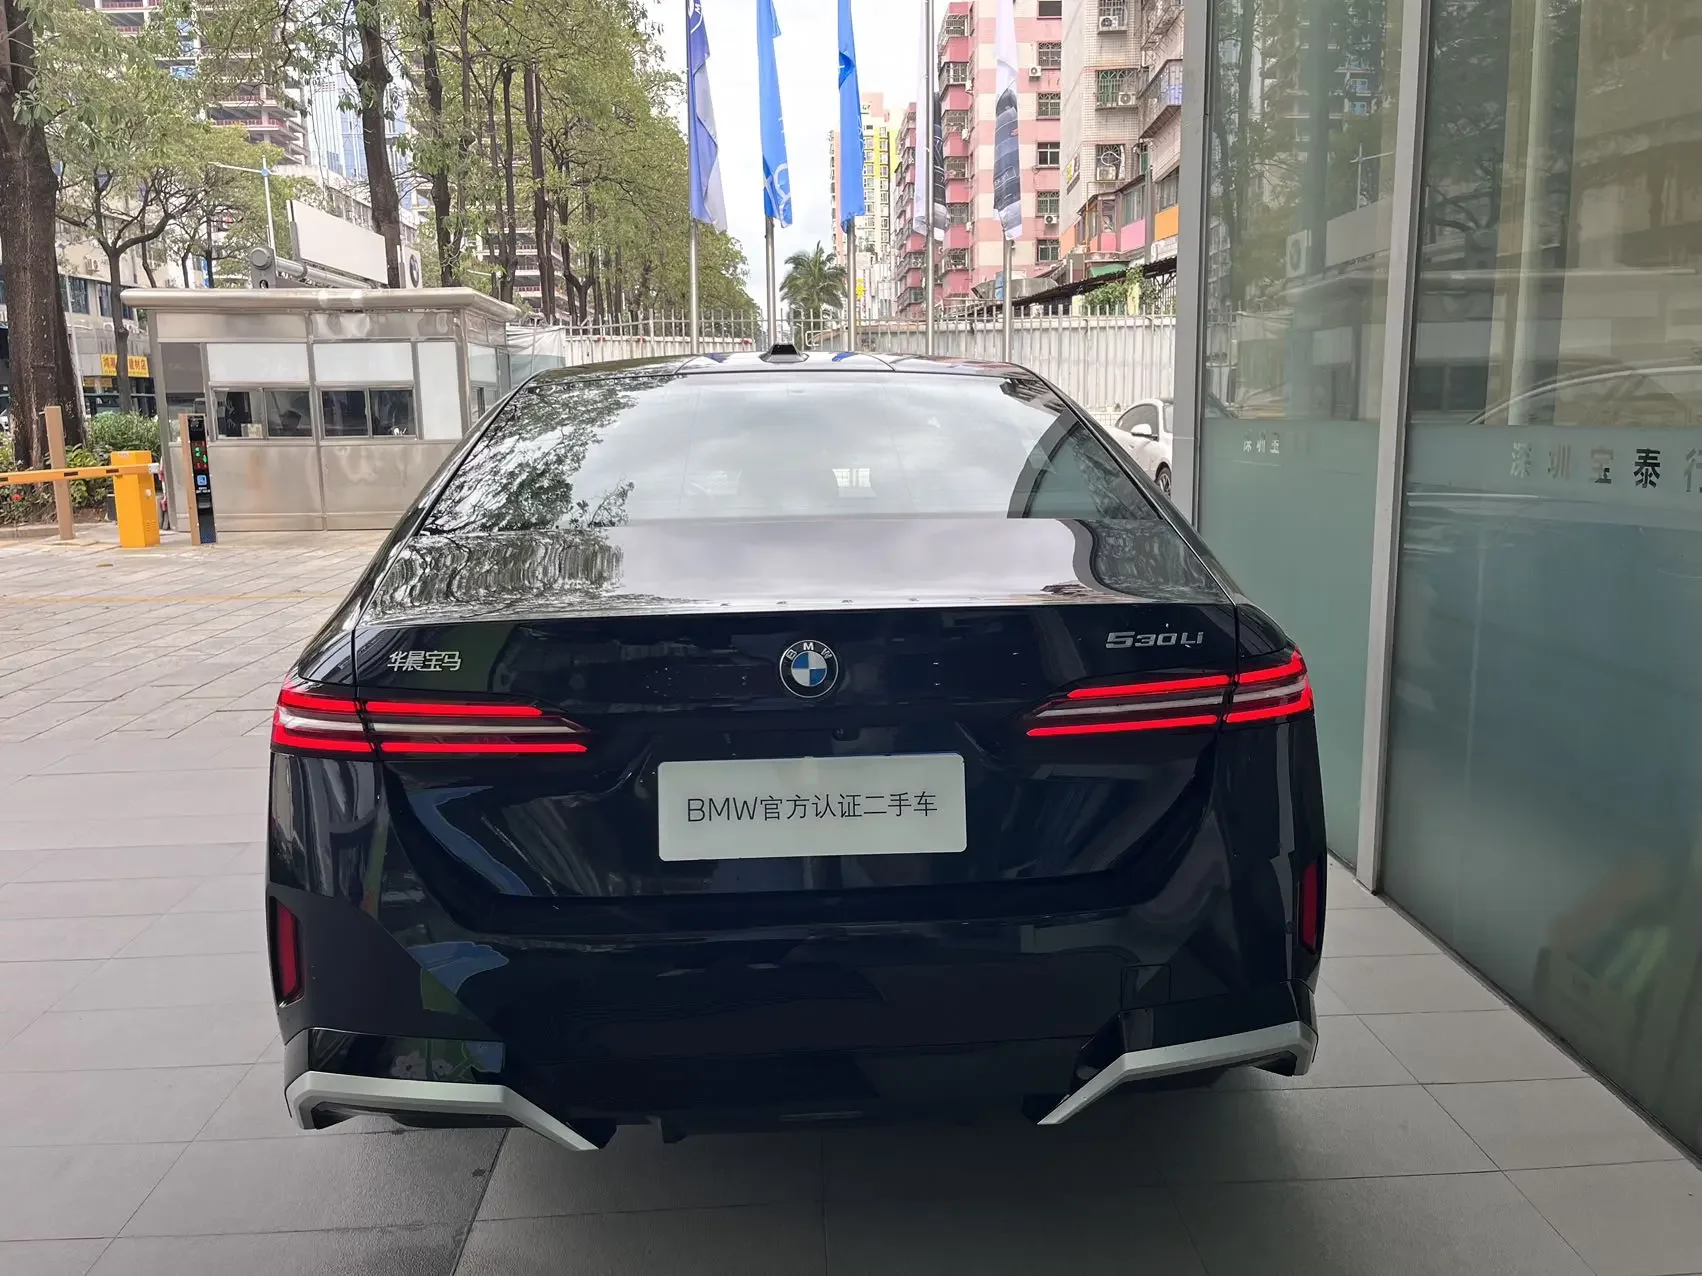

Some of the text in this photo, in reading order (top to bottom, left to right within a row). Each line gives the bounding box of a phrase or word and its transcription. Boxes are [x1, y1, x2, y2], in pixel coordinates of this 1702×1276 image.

[1105, 631, 1204, 649] 530Li
[387, 650, 462, 672] 华晨宝马
[785, 642, 833, 660] BMW
[687, 791, 938, 823] BMW官方认证二手车
